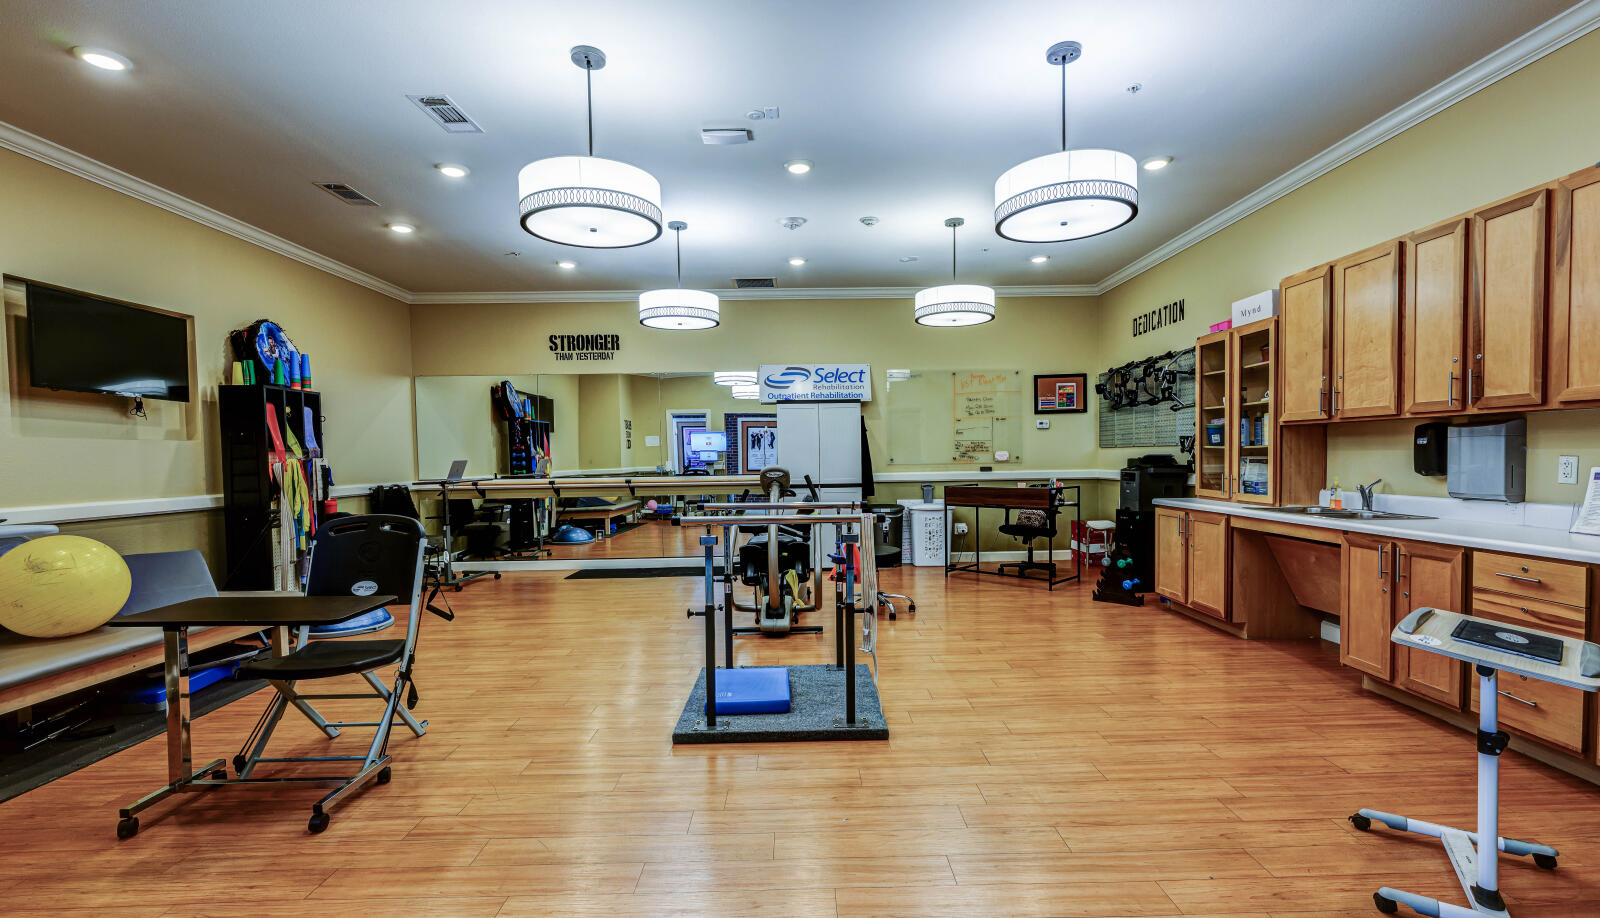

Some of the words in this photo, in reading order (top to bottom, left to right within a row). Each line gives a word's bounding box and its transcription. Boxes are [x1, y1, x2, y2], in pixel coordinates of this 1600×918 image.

[1133, 299, 1185, 337] DEDICATION
[1240, 304, 1262, 317] Mynd
[548, 334, 620, 351] STRONGER
[554, 352, 573, 361] THAN
[576, 352, 614, 361] YESTERDAY
[813, 367, 866, 384] Select
[767, 392, 809, 400] Outpatient
[810, 391, 864, 399] Rehabilitation
